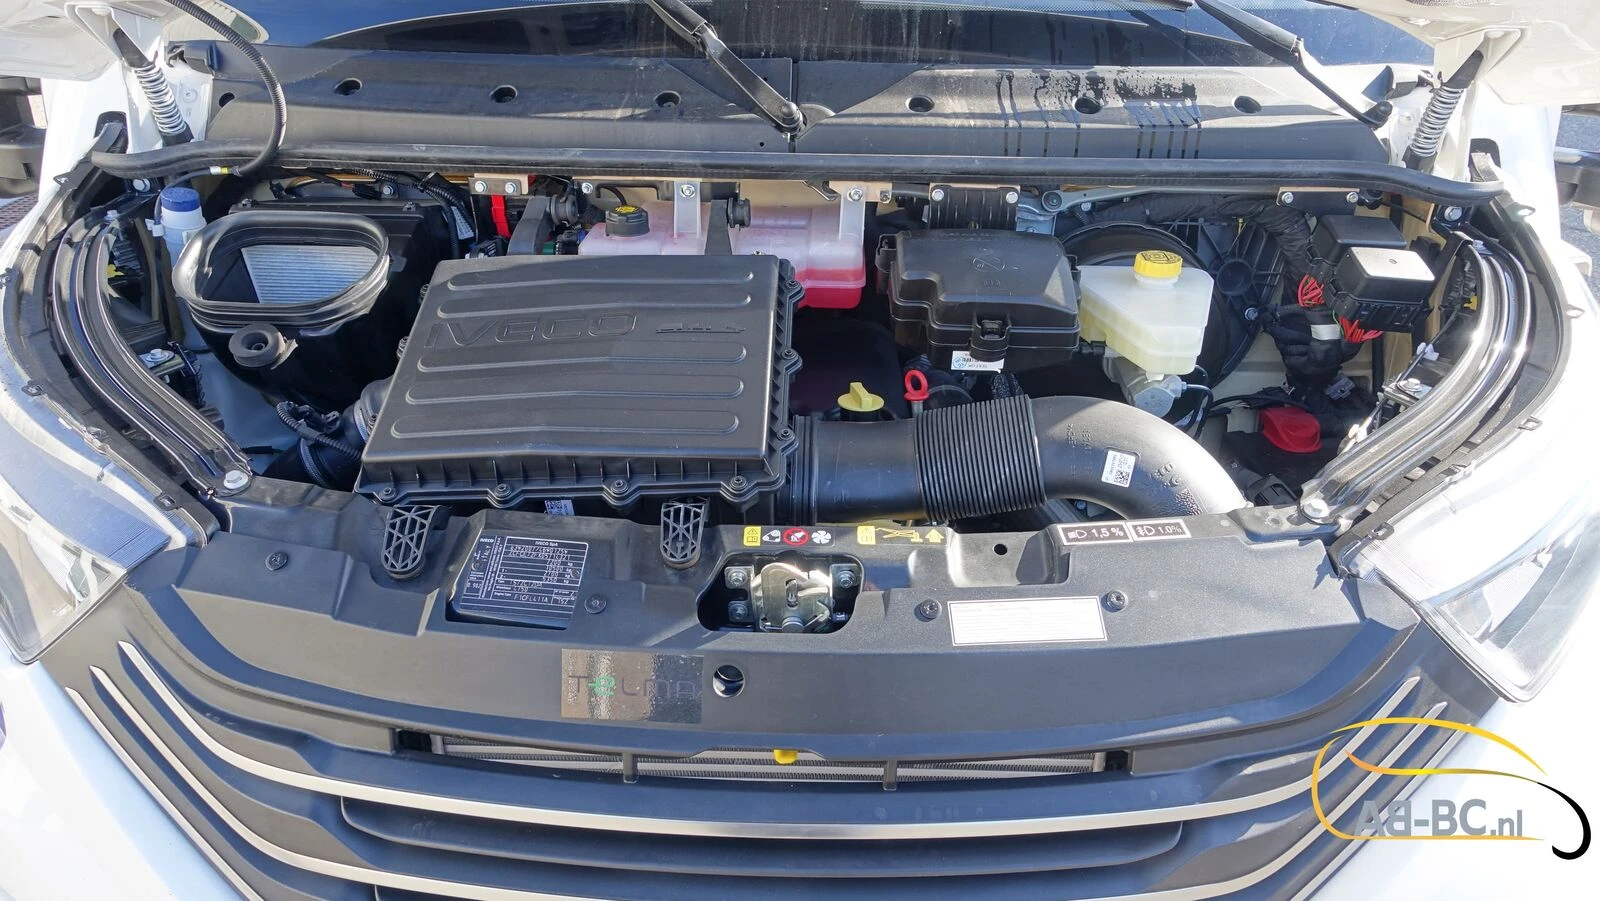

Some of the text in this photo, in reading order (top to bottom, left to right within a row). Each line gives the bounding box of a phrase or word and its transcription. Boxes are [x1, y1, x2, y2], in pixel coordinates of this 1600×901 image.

[424, 313, 637, 348] IVECO
[1091, 527, 1124, 539] 1,5 %
